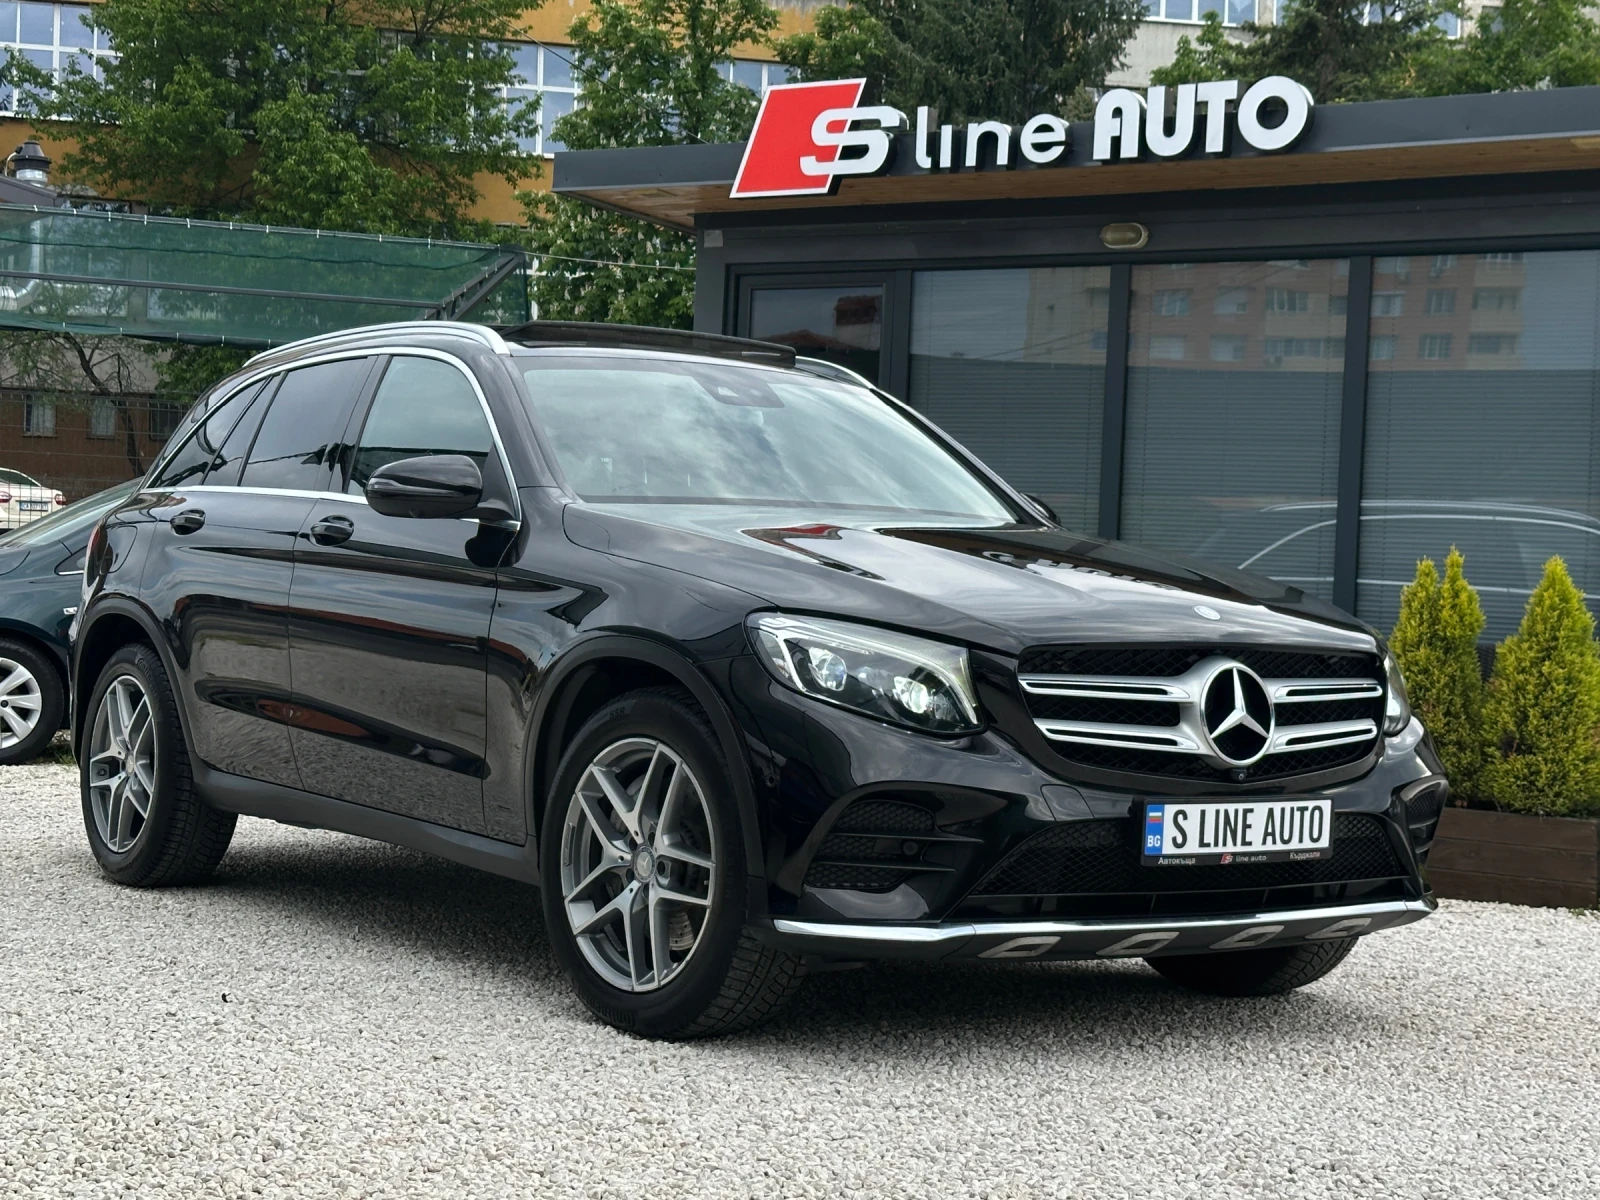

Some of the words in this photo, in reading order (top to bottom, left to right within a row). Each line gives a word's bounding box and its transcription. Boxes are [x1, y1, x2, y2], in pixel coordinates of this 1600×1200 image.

[800, 105, 902, 177] S
[915, 106, 1067, 169] line
[1093, 76, 1311, 160] AUTO
[1147, 835, 1161, 847] BG
[1171, 809, 1188, 849] S
[1198, 808, 1254, 848] LINE
[1261, 805, 1324, 846] AUTO
[1158, 857, 1196, 865] Автокъща
